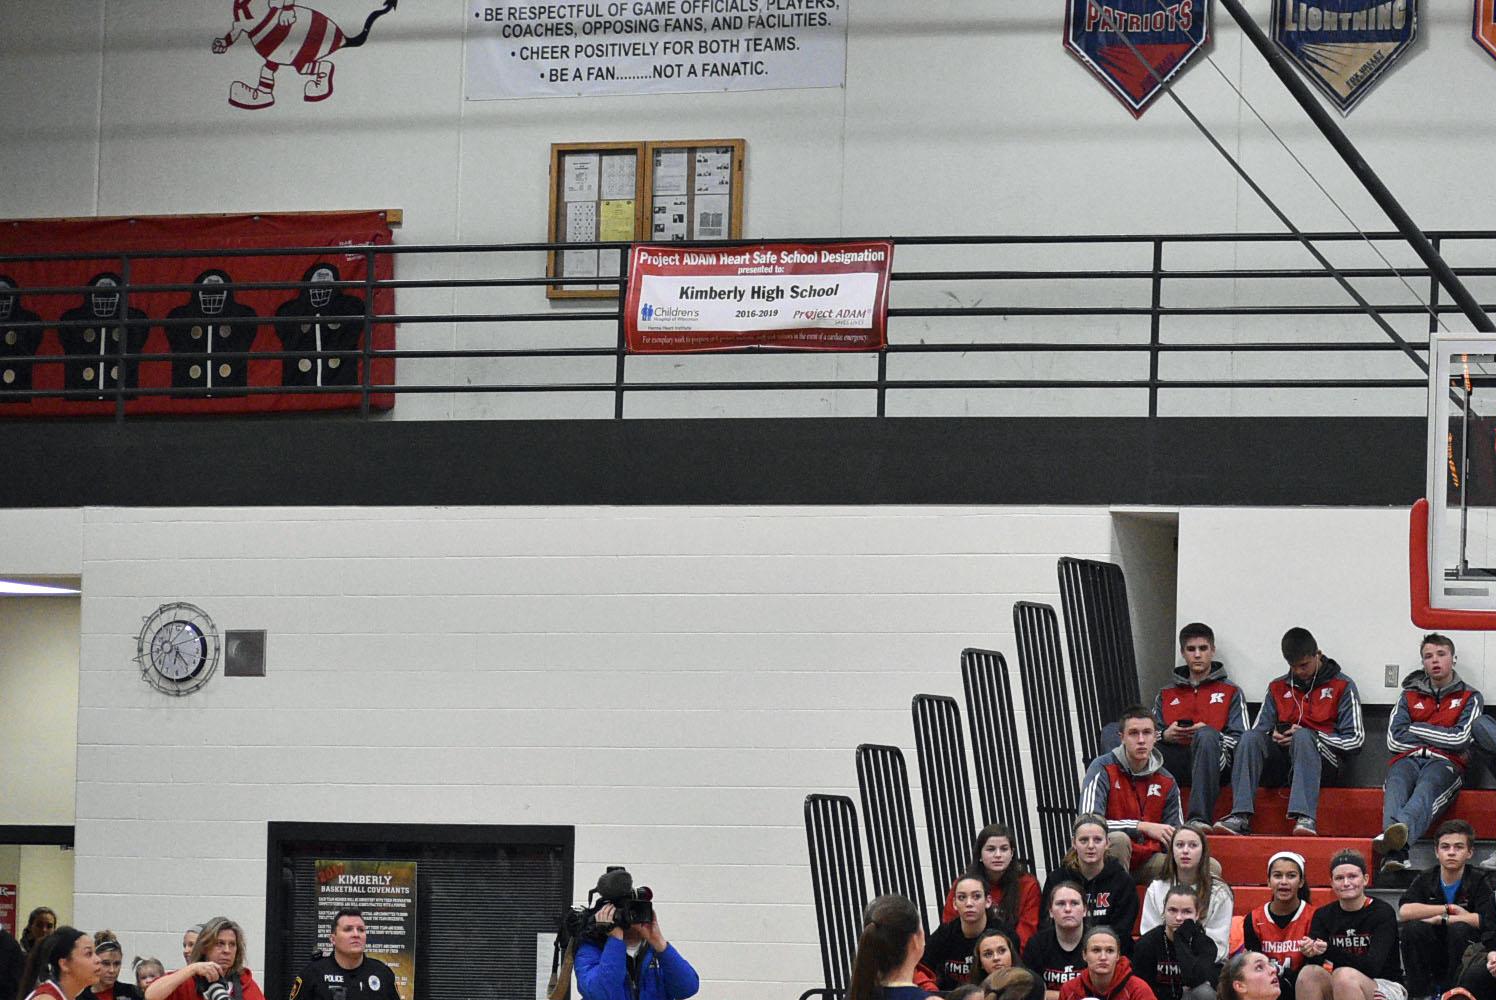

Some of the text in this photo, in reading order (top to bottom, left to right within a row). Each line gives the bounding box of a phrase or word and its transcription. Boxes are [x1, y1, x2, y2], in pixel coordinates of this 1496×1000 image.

[484, 0, 840, 22] BE RESPECTFUL OF GAME OFFICIALS, PLAYERS,
[1085, 2, 1192, 32] PATRIOTS
[1285, 1, 1407, 32] LIGHTNING
[502, 13, 832, 39] COACHES, OPPOSING FANS, AND FACILITIES.
[520, 37, 800, 61] CHEER POSITIVELY FOR BOTH TEAMS.
[549, 68, 568, 82] BE
[572, 67, 583, 81] A
[686, 62, 698, 77] A
[702, 61, 768, 77] FANATIC.
[639, 249, 885, 266] Project ADAM Heart Safe School Designation
[738, 265, 785, 275] presented to:
[679, 284, 839, 302] Kimberly High School
[654, 307, 700, 318] Children's
[735, 309, 779, 318] 2016-2019
[338, 874, 393, 885] KIMBERLY
[320, 886, 410, 894] BASKETBALL COVENANTS
[324, 974, 344, 983] POLICE
